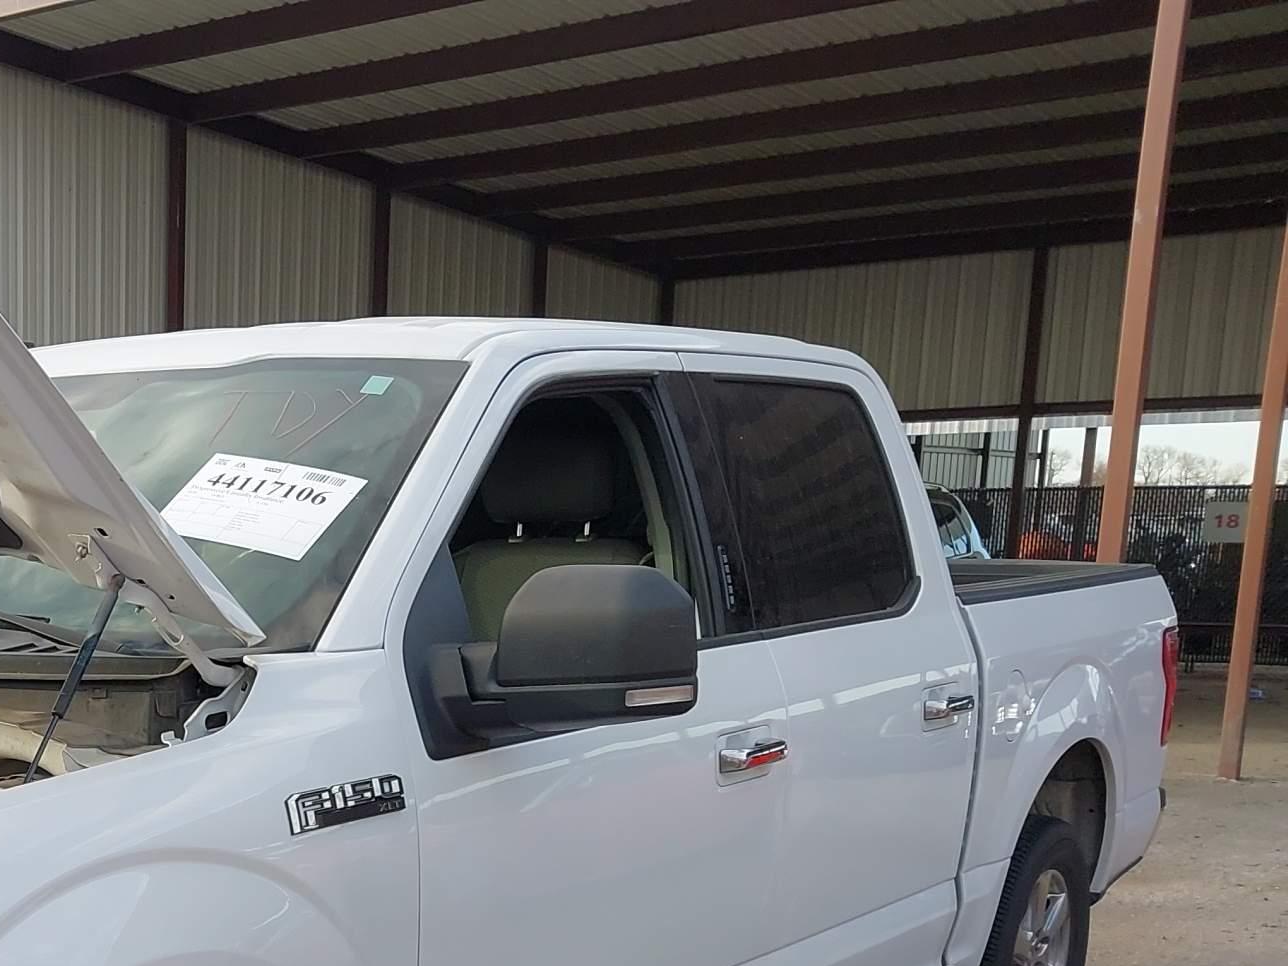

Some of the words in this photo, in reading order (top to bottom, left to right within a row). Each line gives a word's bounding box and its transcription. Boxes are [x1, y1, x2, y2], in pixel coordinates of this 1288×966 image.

[207, 473, 335, 505] 44117106
[1214, 514, 1240, 529] 18
[378, 800, 401, 812] XLT
